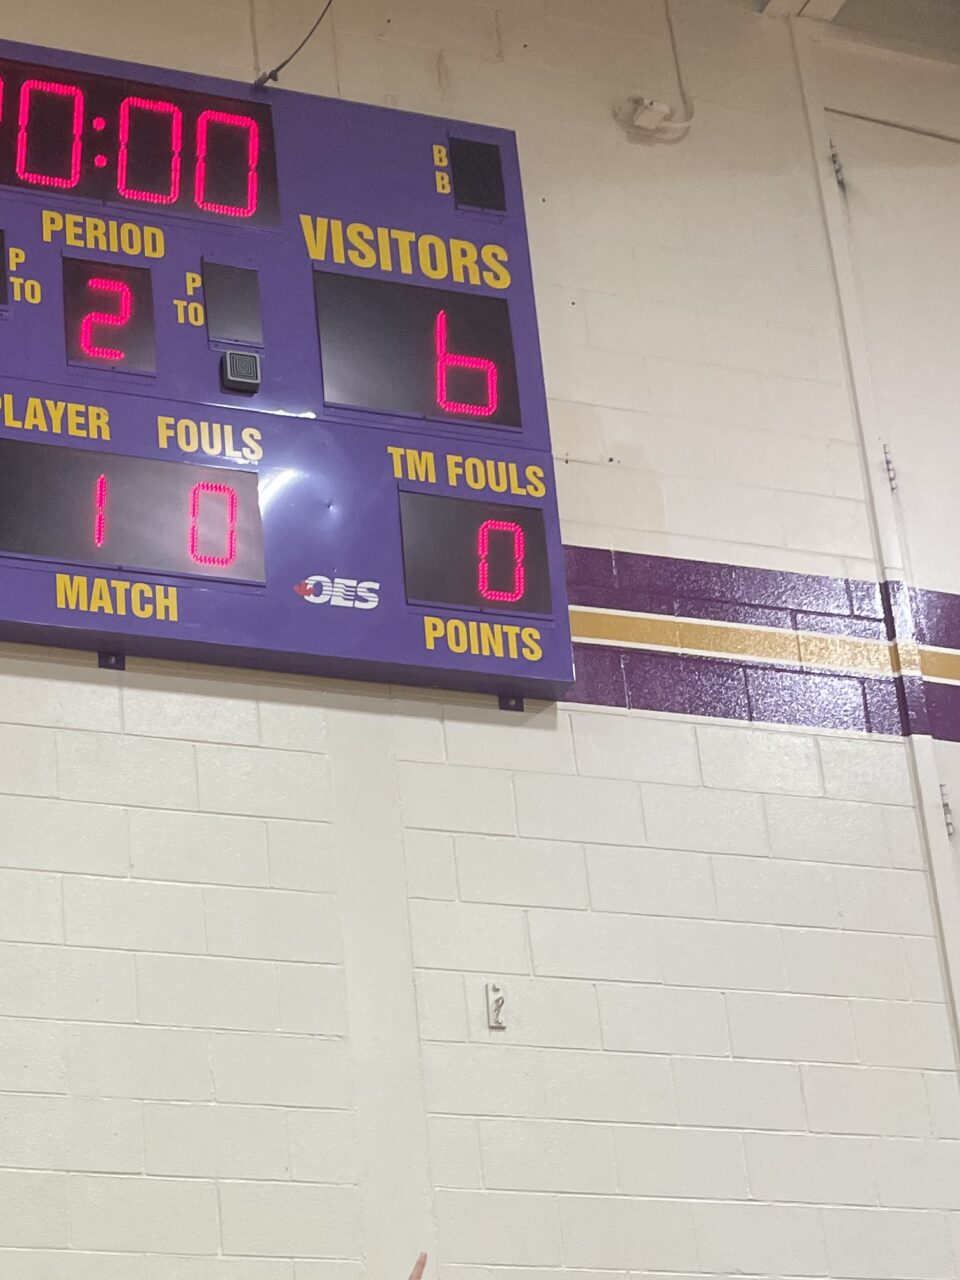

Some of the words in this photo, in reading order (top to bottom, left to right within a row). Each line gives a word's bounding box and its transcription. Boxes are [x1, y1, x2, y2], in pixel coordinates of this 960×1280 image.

[432, 144, 449, 168] B
[435, 171, 451, 194] B
[42, 210, 166, 259] PERIOD
[299, 214, 512, 289] VISITORS
[9, 247, 26, 271] P
[9, 276, 41, 305] TO
[185, 271, 202, 296] P
[79, 277, 133, 361] 2
[173, 299, 205, 327] TO
[157, 415, 264, 461] FOULS
[387, 446, 436, 484] TM
[446, 455, 546, 498] FOULS
[477, 519, 525, 602] 0
[55, 573, 178, 622] MATCH
[303, 575, 380, 609] OES
[424, 616, 543, 661] POINTS
